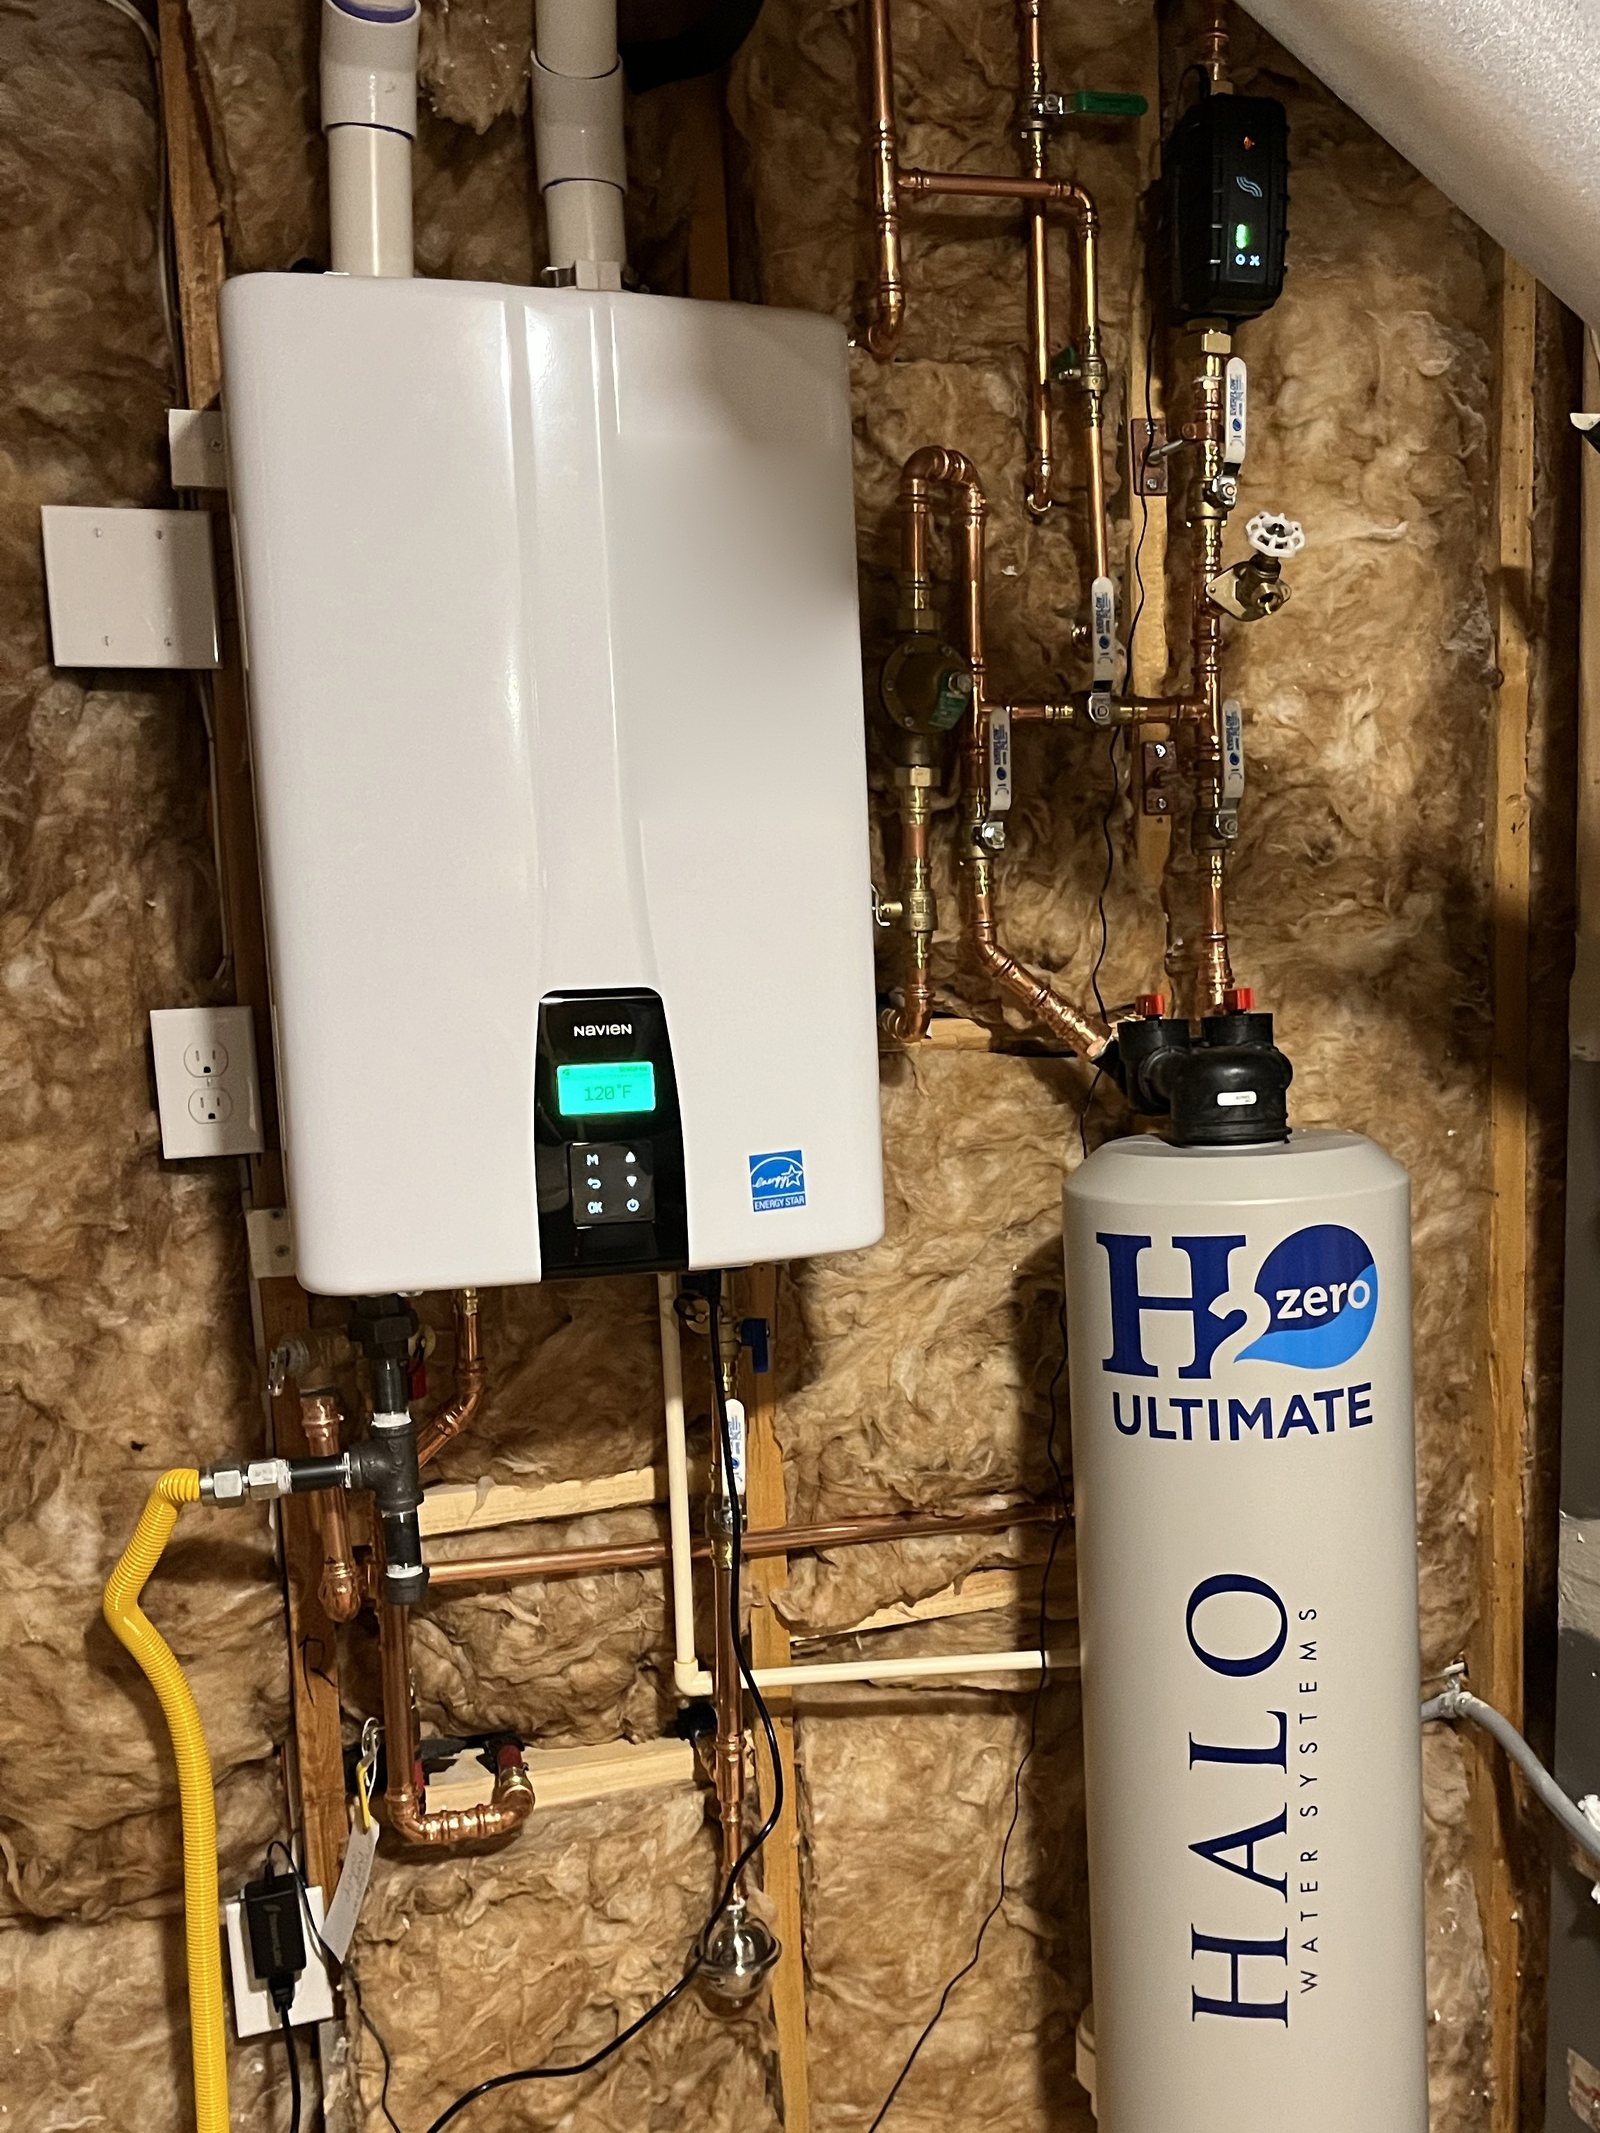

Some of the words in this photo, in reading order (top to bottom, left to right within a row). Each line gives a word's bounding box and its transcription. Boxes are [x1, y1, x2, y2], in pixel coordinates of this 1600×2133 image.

[586, 1153, 599, 1167] M
[587, 1201, 603, 1214] OK
[754, 1198, 784, 1210] ENERGY
[785, 1195, 805, 1206] STAR
[1276, 1279, 1371, 1320] zero
[1112, 1382, 1373, 1441] ULTIMATE
[1299, 1607, 1318, 1818] SYSTEMS
[1186, 1573, 1288, 2028] HALO
[1300, 1849, 1319, 1994] WATER
